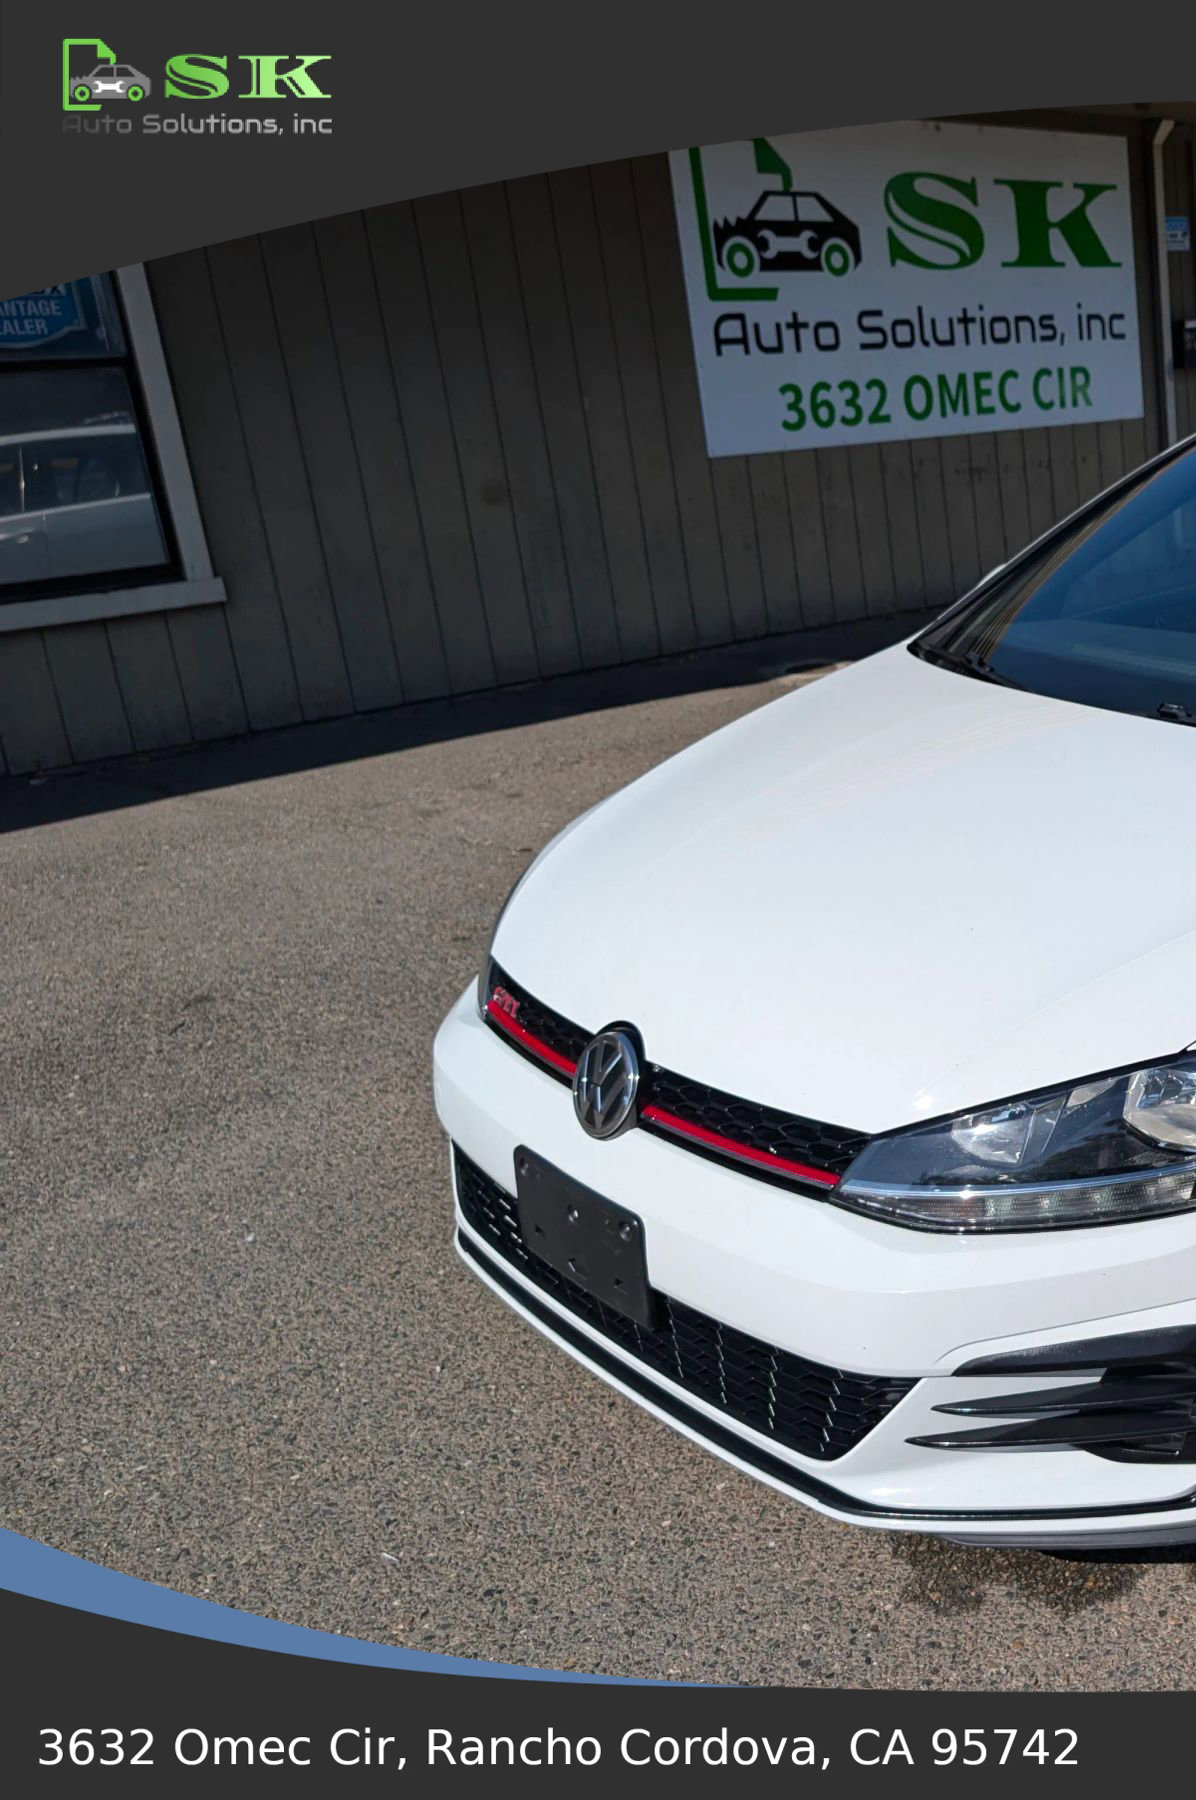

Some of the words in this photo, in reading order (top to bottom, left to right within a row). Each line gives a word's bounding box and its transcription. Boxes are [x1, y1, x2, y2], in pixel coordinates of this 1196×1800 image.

[883, 171, 1122, 269] SK
[0, 318, 49, 336] ALER
[714, 311, 841, 356] Auto
[857, 304, 1066, 350] Solutions,
[1076, 302, 1126, 342] inc
[779, 378, 892, 432] 3632
[903, 370, 1021, 421] OMEC
[1032, 365, 1093, 409] CIR
